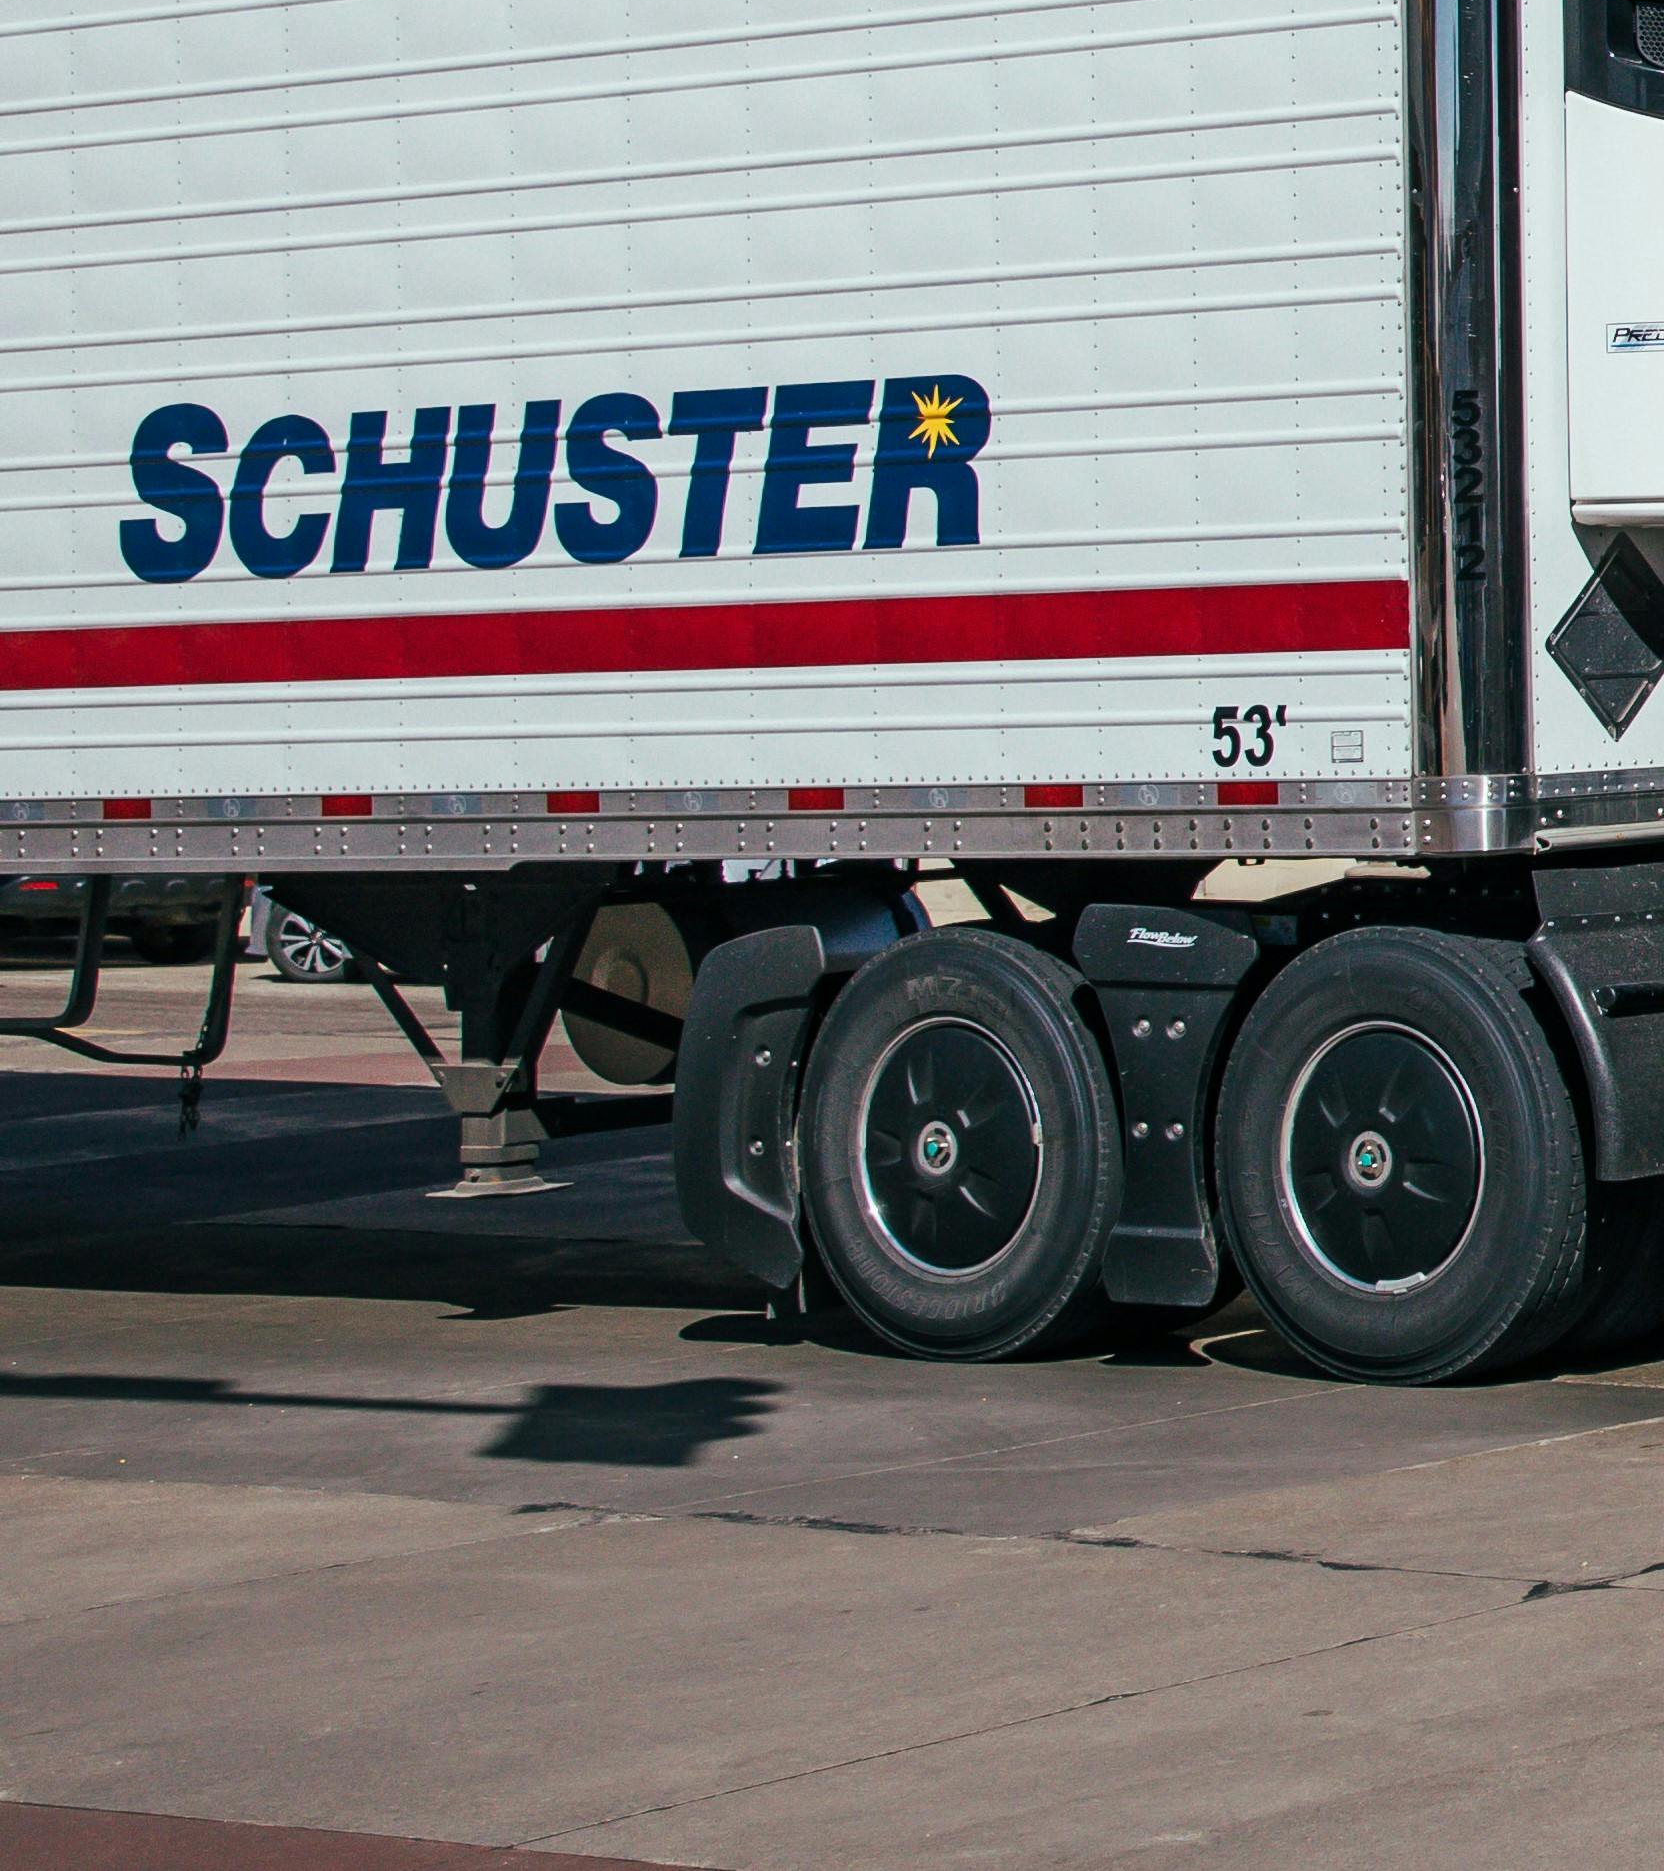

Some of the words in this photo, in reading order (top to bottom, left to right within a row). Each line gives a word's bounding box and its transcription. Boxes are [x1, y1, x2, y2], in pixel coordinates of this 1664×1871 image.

[119, 374, 991, 584] SCHUSTER
[1451, 390, 1487, 581] 53212
[1127, 927, 1198, 947] FlowBelow
